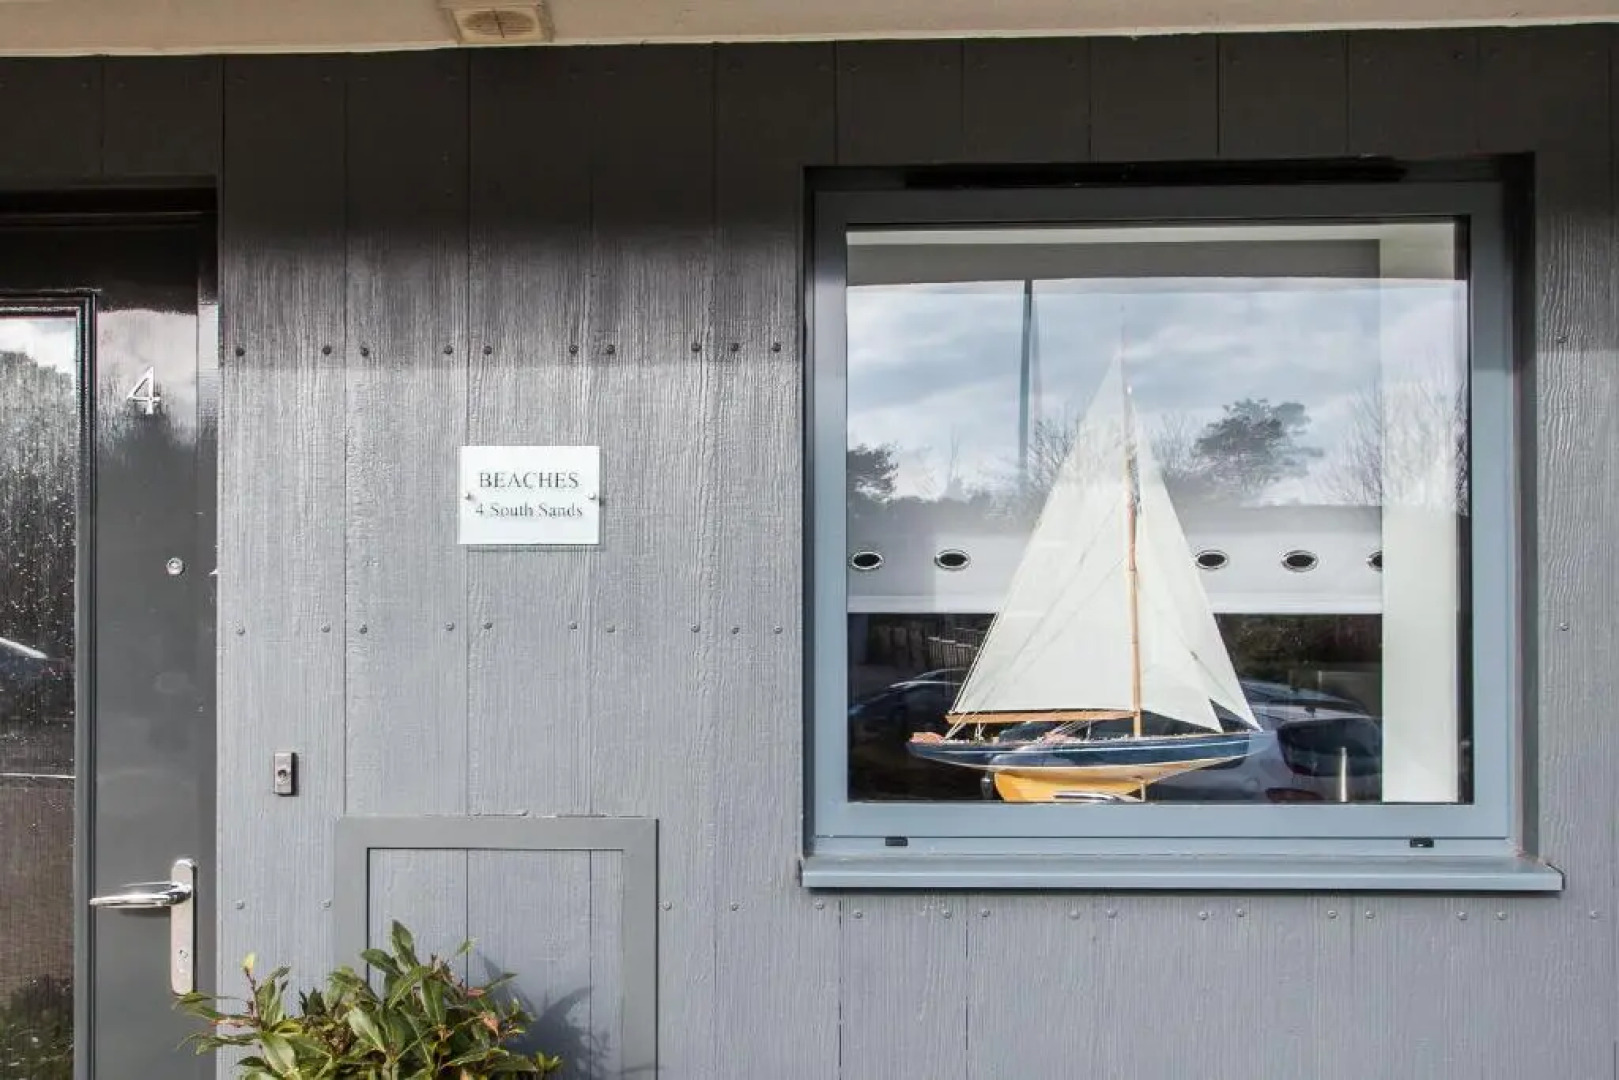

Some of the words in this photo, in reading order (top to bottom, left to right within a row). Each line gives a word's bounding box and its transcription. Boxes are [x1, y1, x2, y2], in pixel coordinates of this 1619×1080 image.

[127, 366, 160, 415] 4
[480, 472, 580, 489] BEACHES
[475, 502, 484, 516] 4
[490, 502, 534, 517] South
[538, 502, 583, 517] Sands
